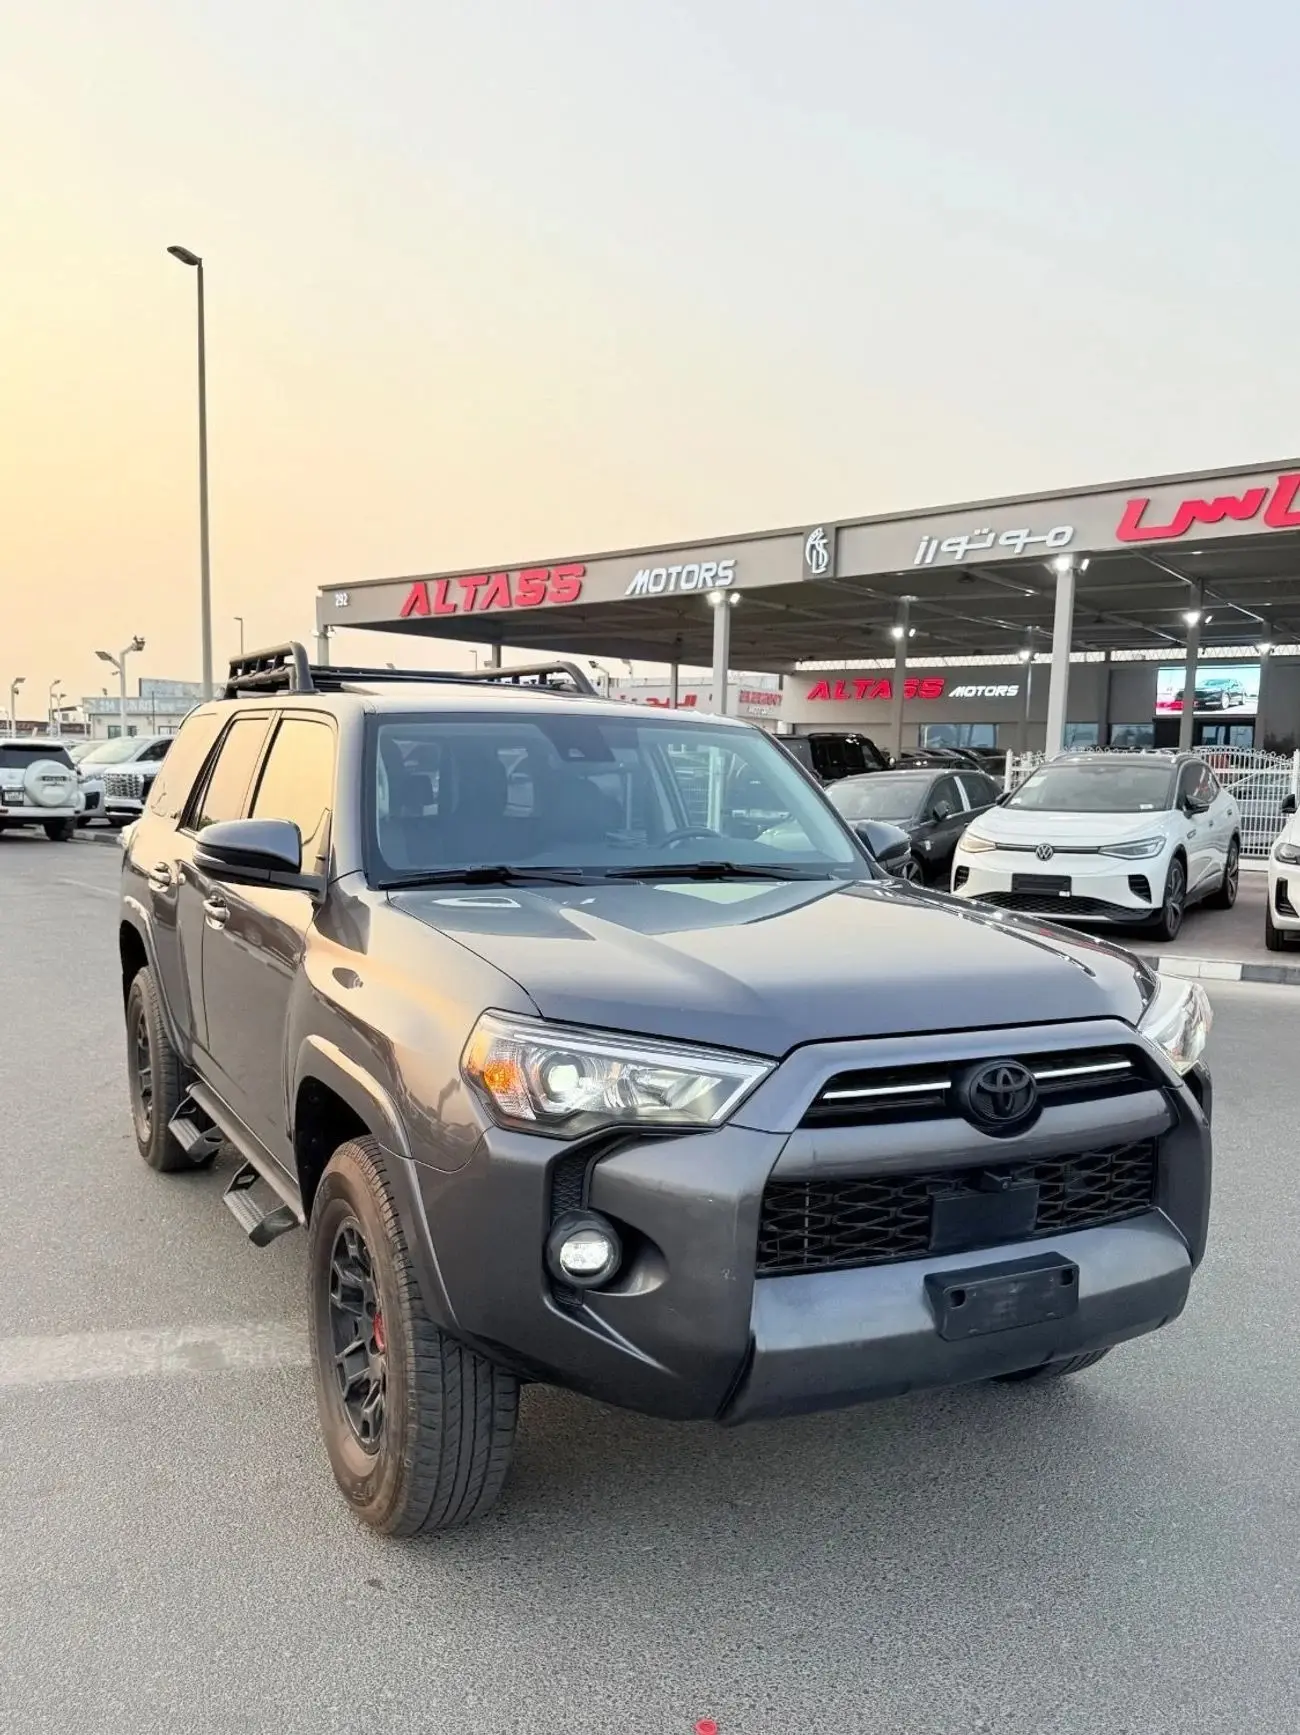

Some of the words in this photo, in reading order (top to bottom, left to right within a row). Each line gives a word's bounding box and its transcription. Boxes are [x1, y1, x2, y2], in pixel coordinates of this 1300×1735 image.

[913, 525, 1074, 565] موتورز
[335, 592, 349, 606] 292
[399, 562, 586, 617] ALTASS
[624, 559, 737, 596] MOTORS
[807, 677, 945, 700] ALTASS
[949, 684, 1020, 699] MOTORS
